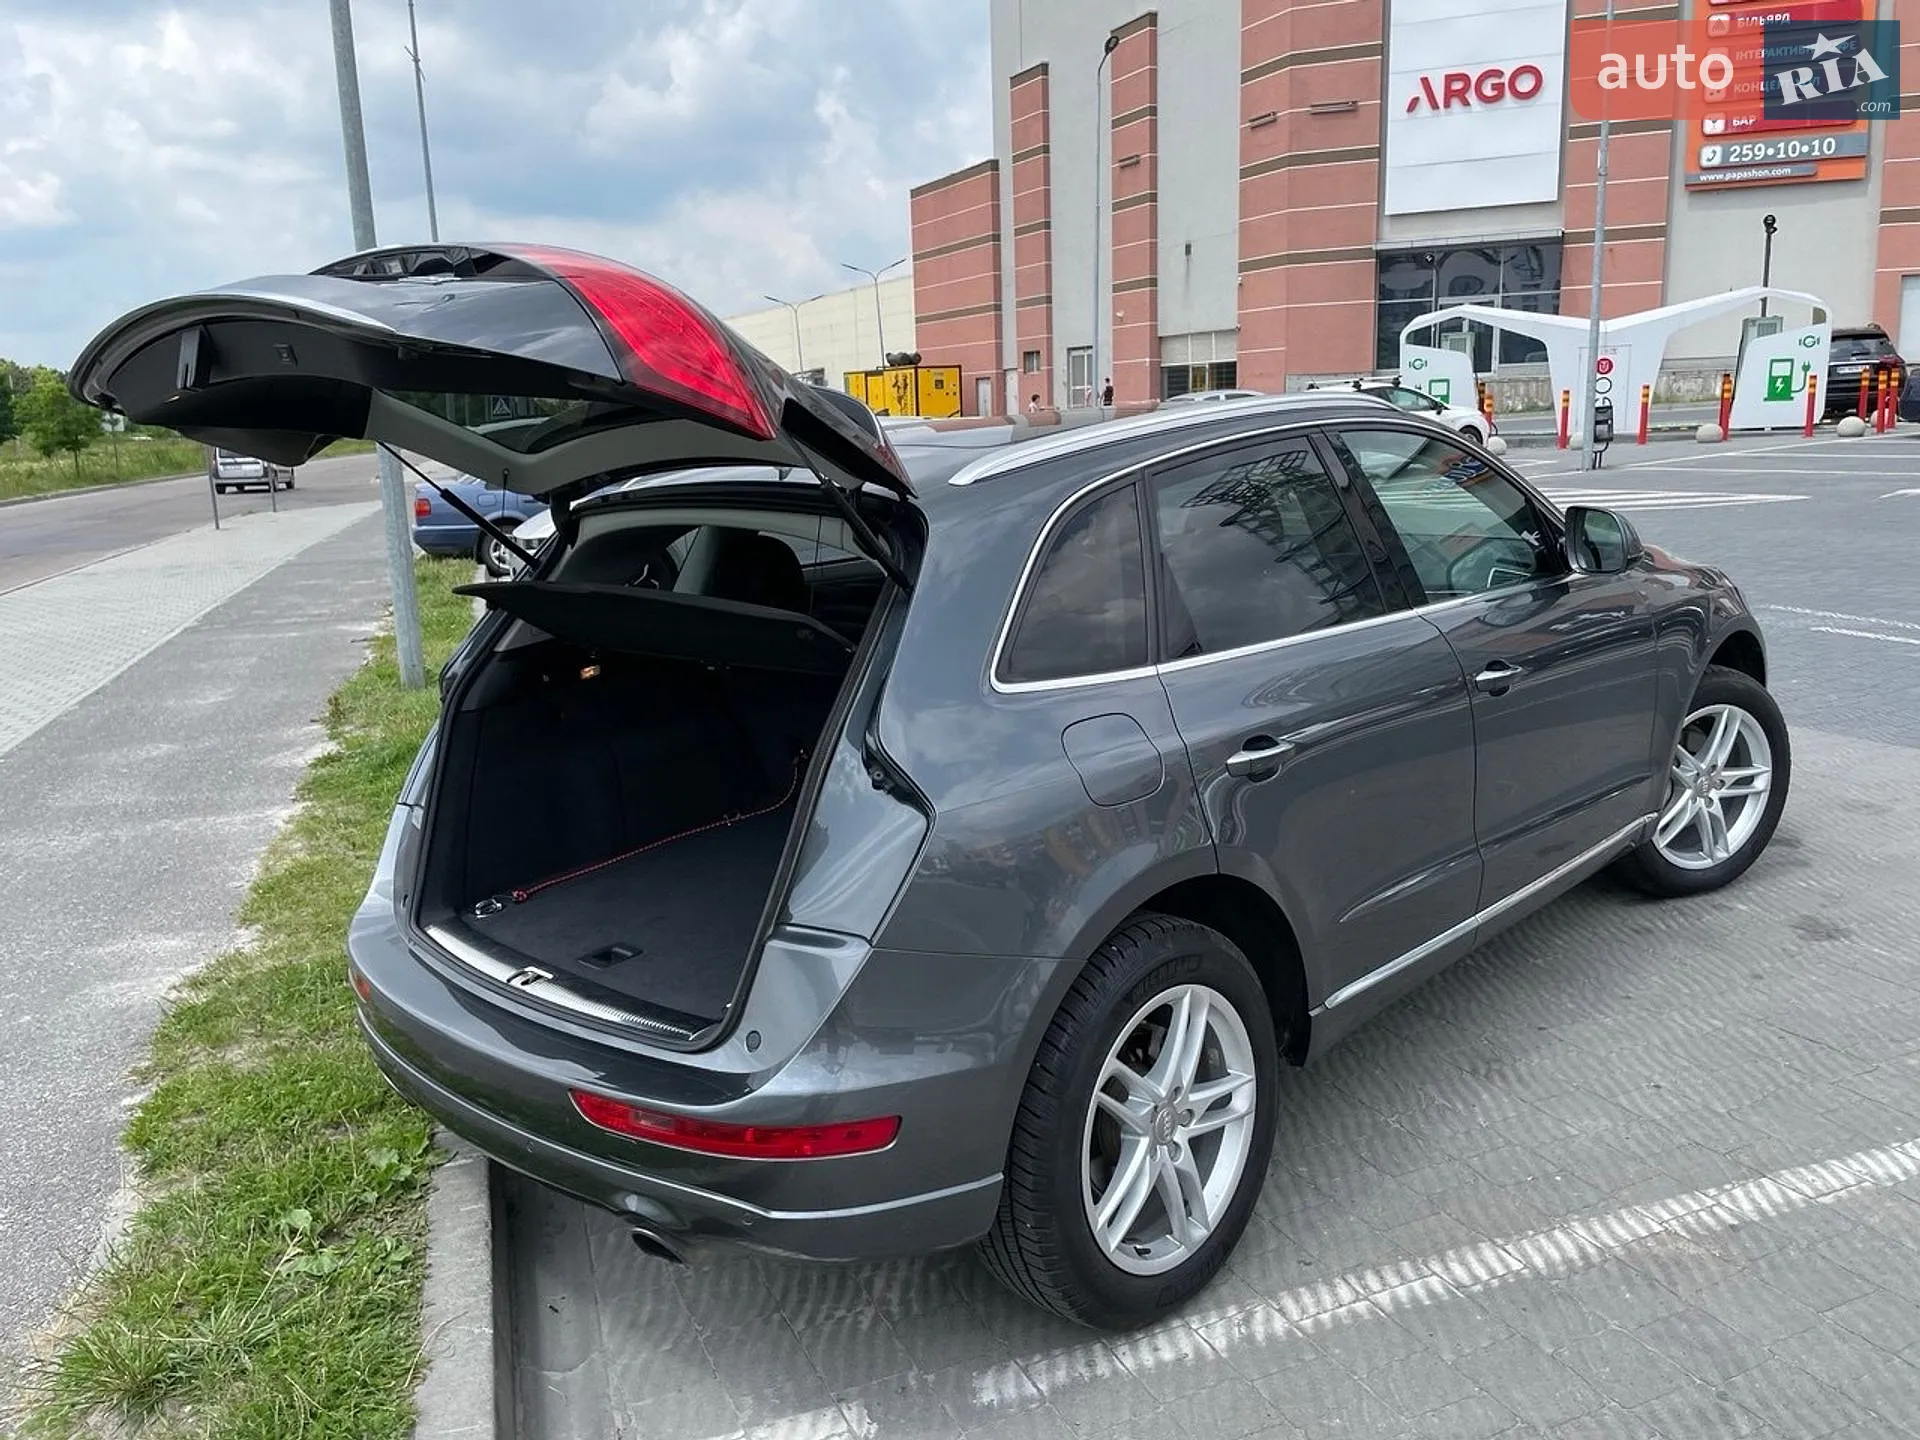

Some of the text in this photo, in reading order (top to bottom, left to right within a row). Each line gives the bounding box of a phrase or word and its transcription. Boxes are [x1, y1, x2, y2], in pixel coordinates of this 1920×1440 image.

[1737, 13, 1791, 29] БІЛЬЯРД
[1406, 65, 1543, 113] ARGO
[1699, 166, 1791, 182] www.papashon.com
